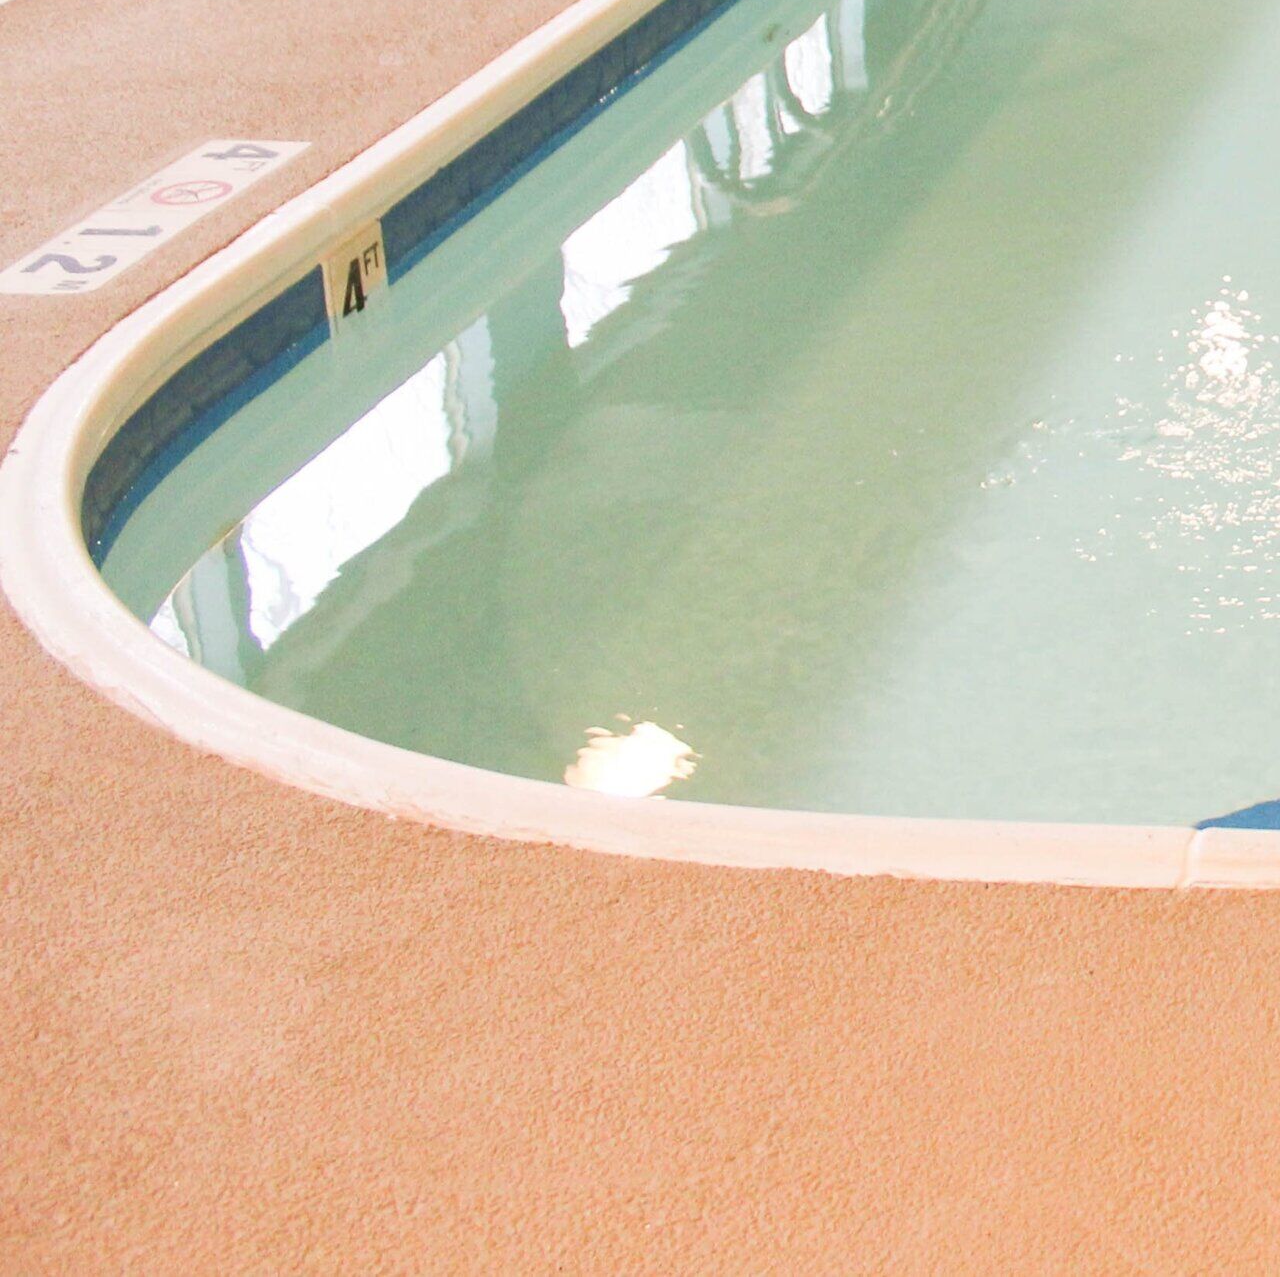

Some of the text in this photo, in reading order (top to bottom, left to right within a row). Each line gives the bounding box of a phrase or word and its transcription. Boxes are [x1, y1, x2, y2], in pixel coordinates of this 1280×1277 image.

[202, 143, 279, 160] 4
[343, 240, 380, 318] 4 FT
